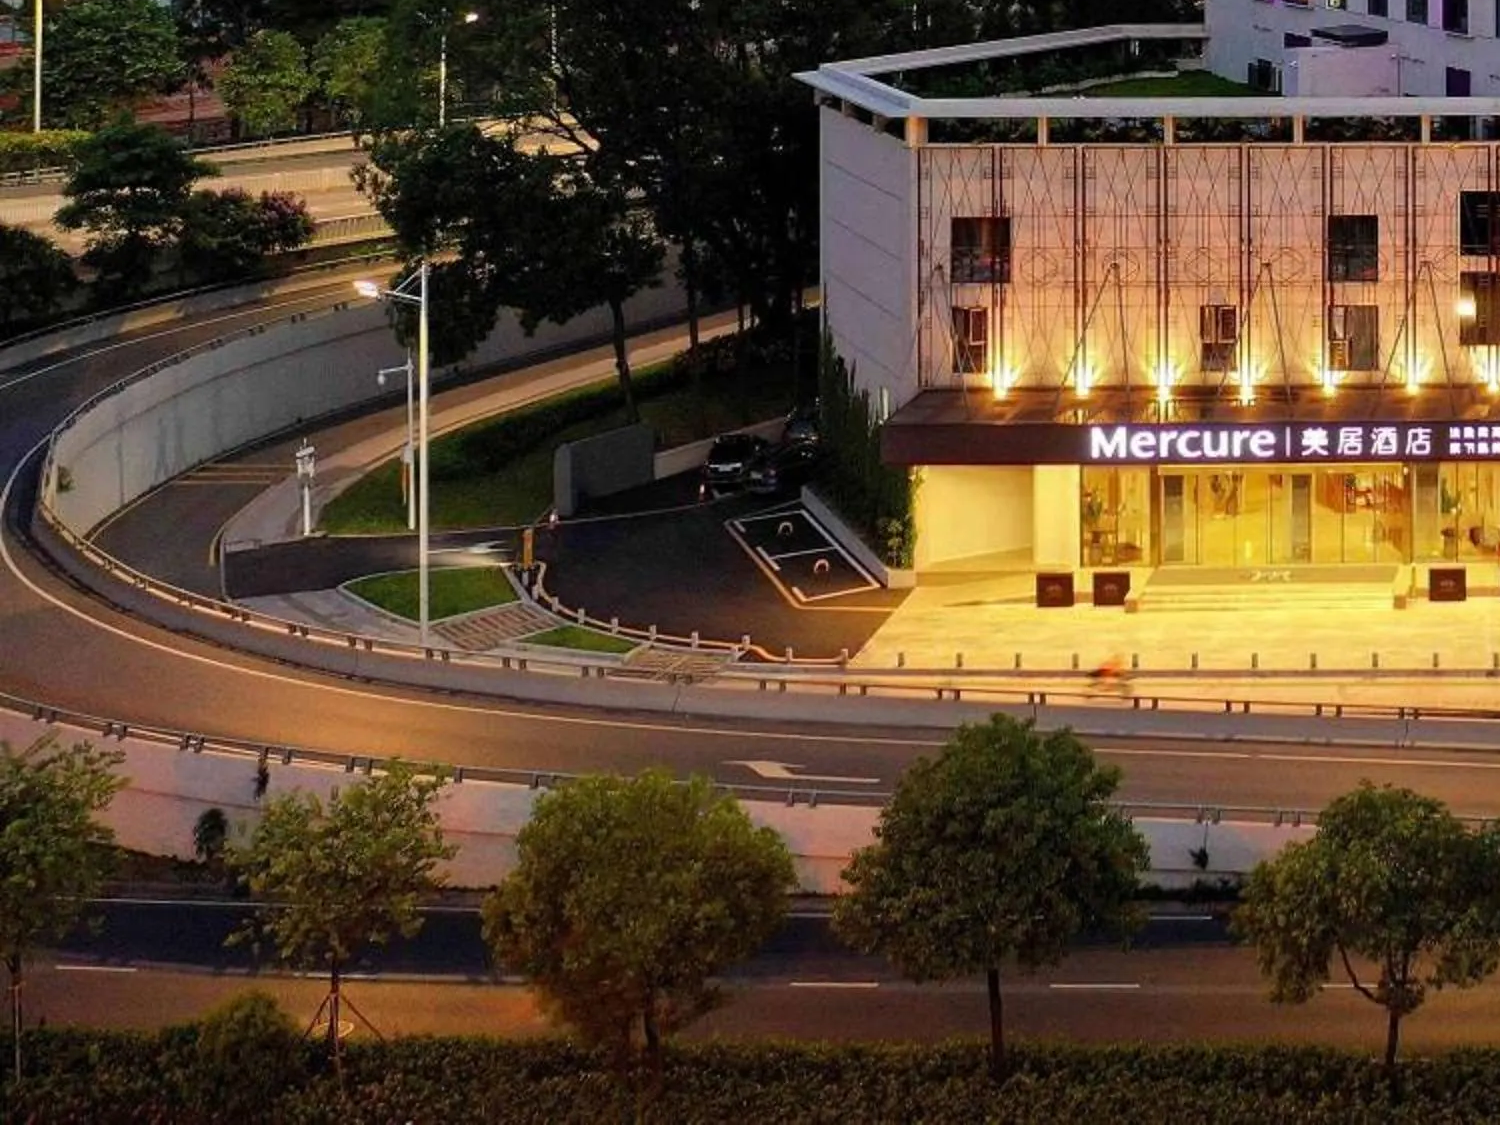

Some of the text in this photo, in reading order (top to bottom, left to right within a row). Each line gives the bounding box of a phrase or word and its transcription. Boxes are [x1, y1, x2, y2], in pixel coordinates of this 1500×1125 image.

[1090, 426, 1276, 459] Mercure
[1301, 426, 1431, 456] 美居酒店
